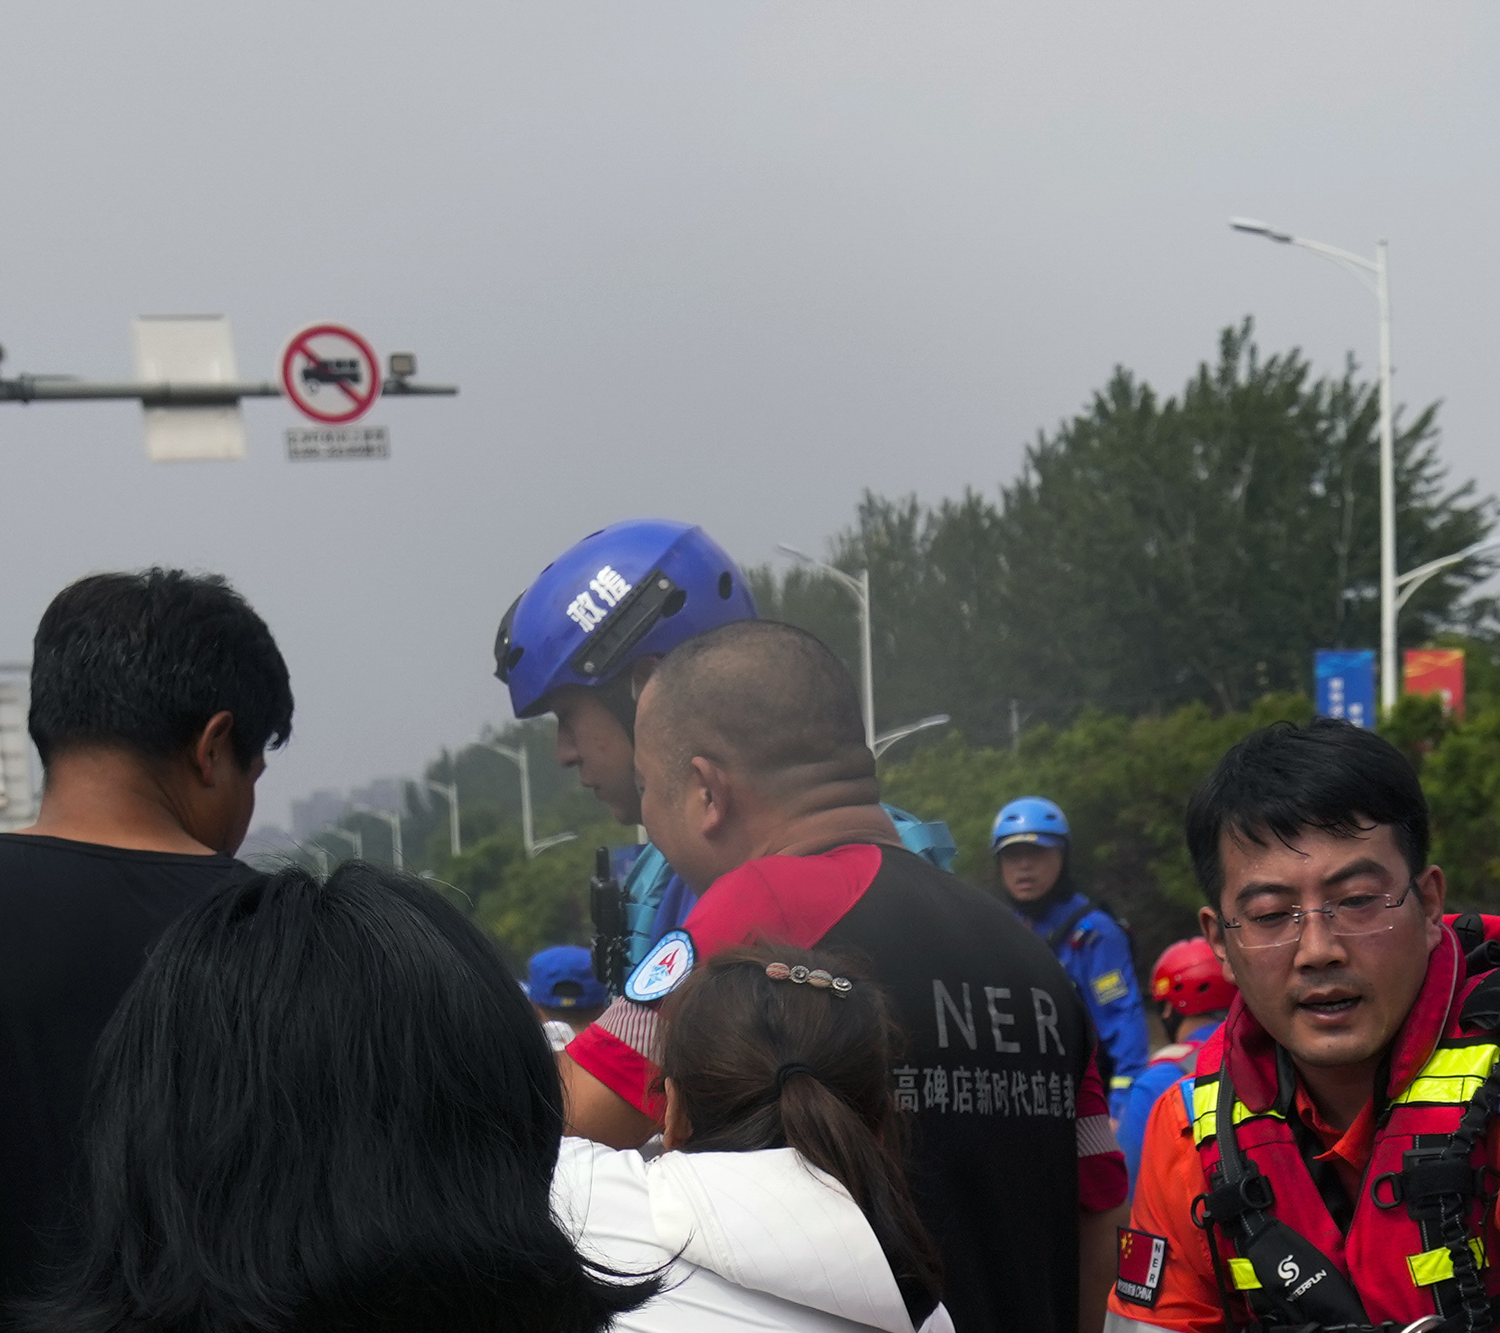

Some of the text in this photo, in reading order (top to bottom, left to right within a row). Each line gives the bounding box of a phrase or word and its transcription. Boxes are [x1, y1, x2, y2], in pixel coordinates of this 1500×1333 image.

[565, 565, 632, 633] 救援
[932, 979, 1066, 1056] NER
[1149, 1243, 1161, 1283] NER
